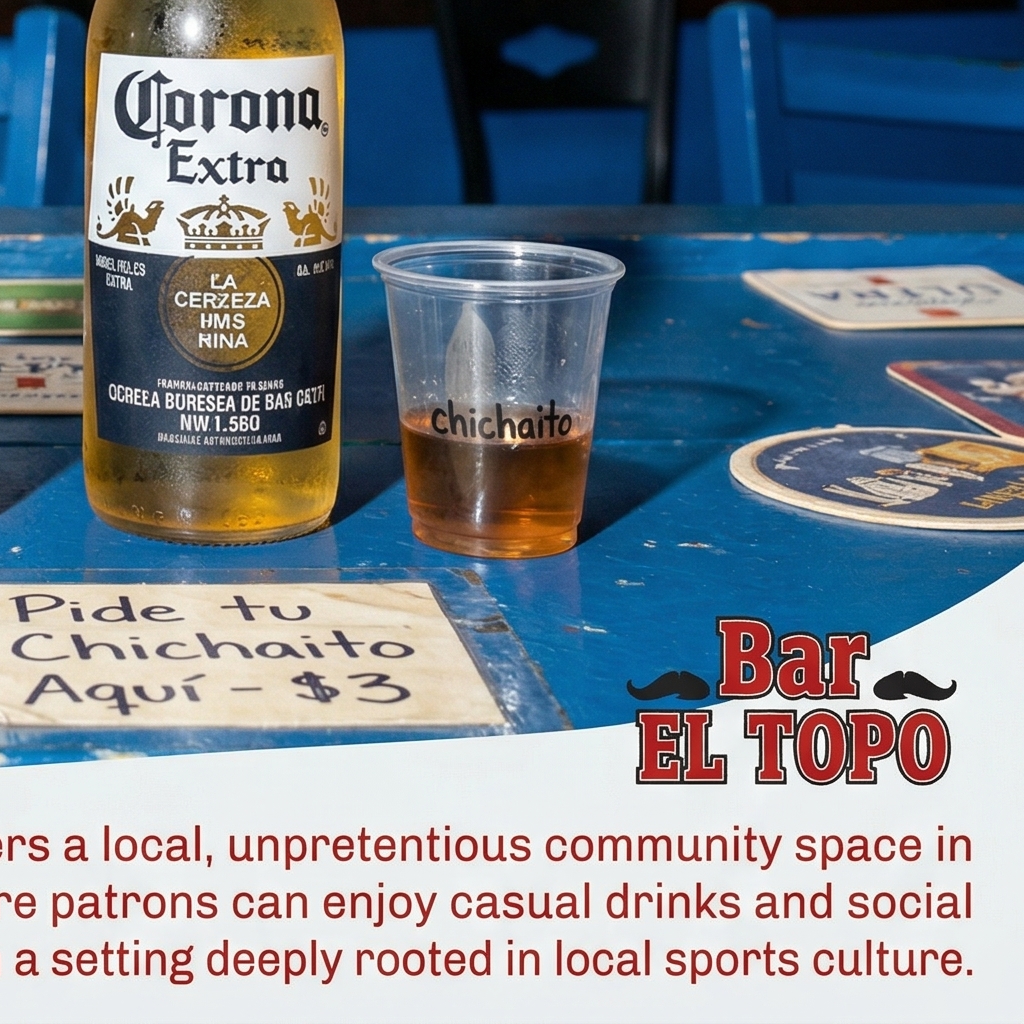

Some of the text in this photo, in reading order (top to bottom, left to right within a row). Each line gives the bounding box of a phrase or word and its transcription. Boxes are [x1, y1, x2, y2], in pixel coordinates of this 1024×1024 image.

[114, 69, 322, 148] Corona
[167, 138, 289, 185] Extra
[241, 394, 261, 412] DE
[431, 399, 573, 440] chichaito
[9, 593, 313, 624] Pide tu
[11, 630, 416, 661] Chichaito
[24, 673, 208, 717] Aquí
[291, 670, 413, 705] $3
